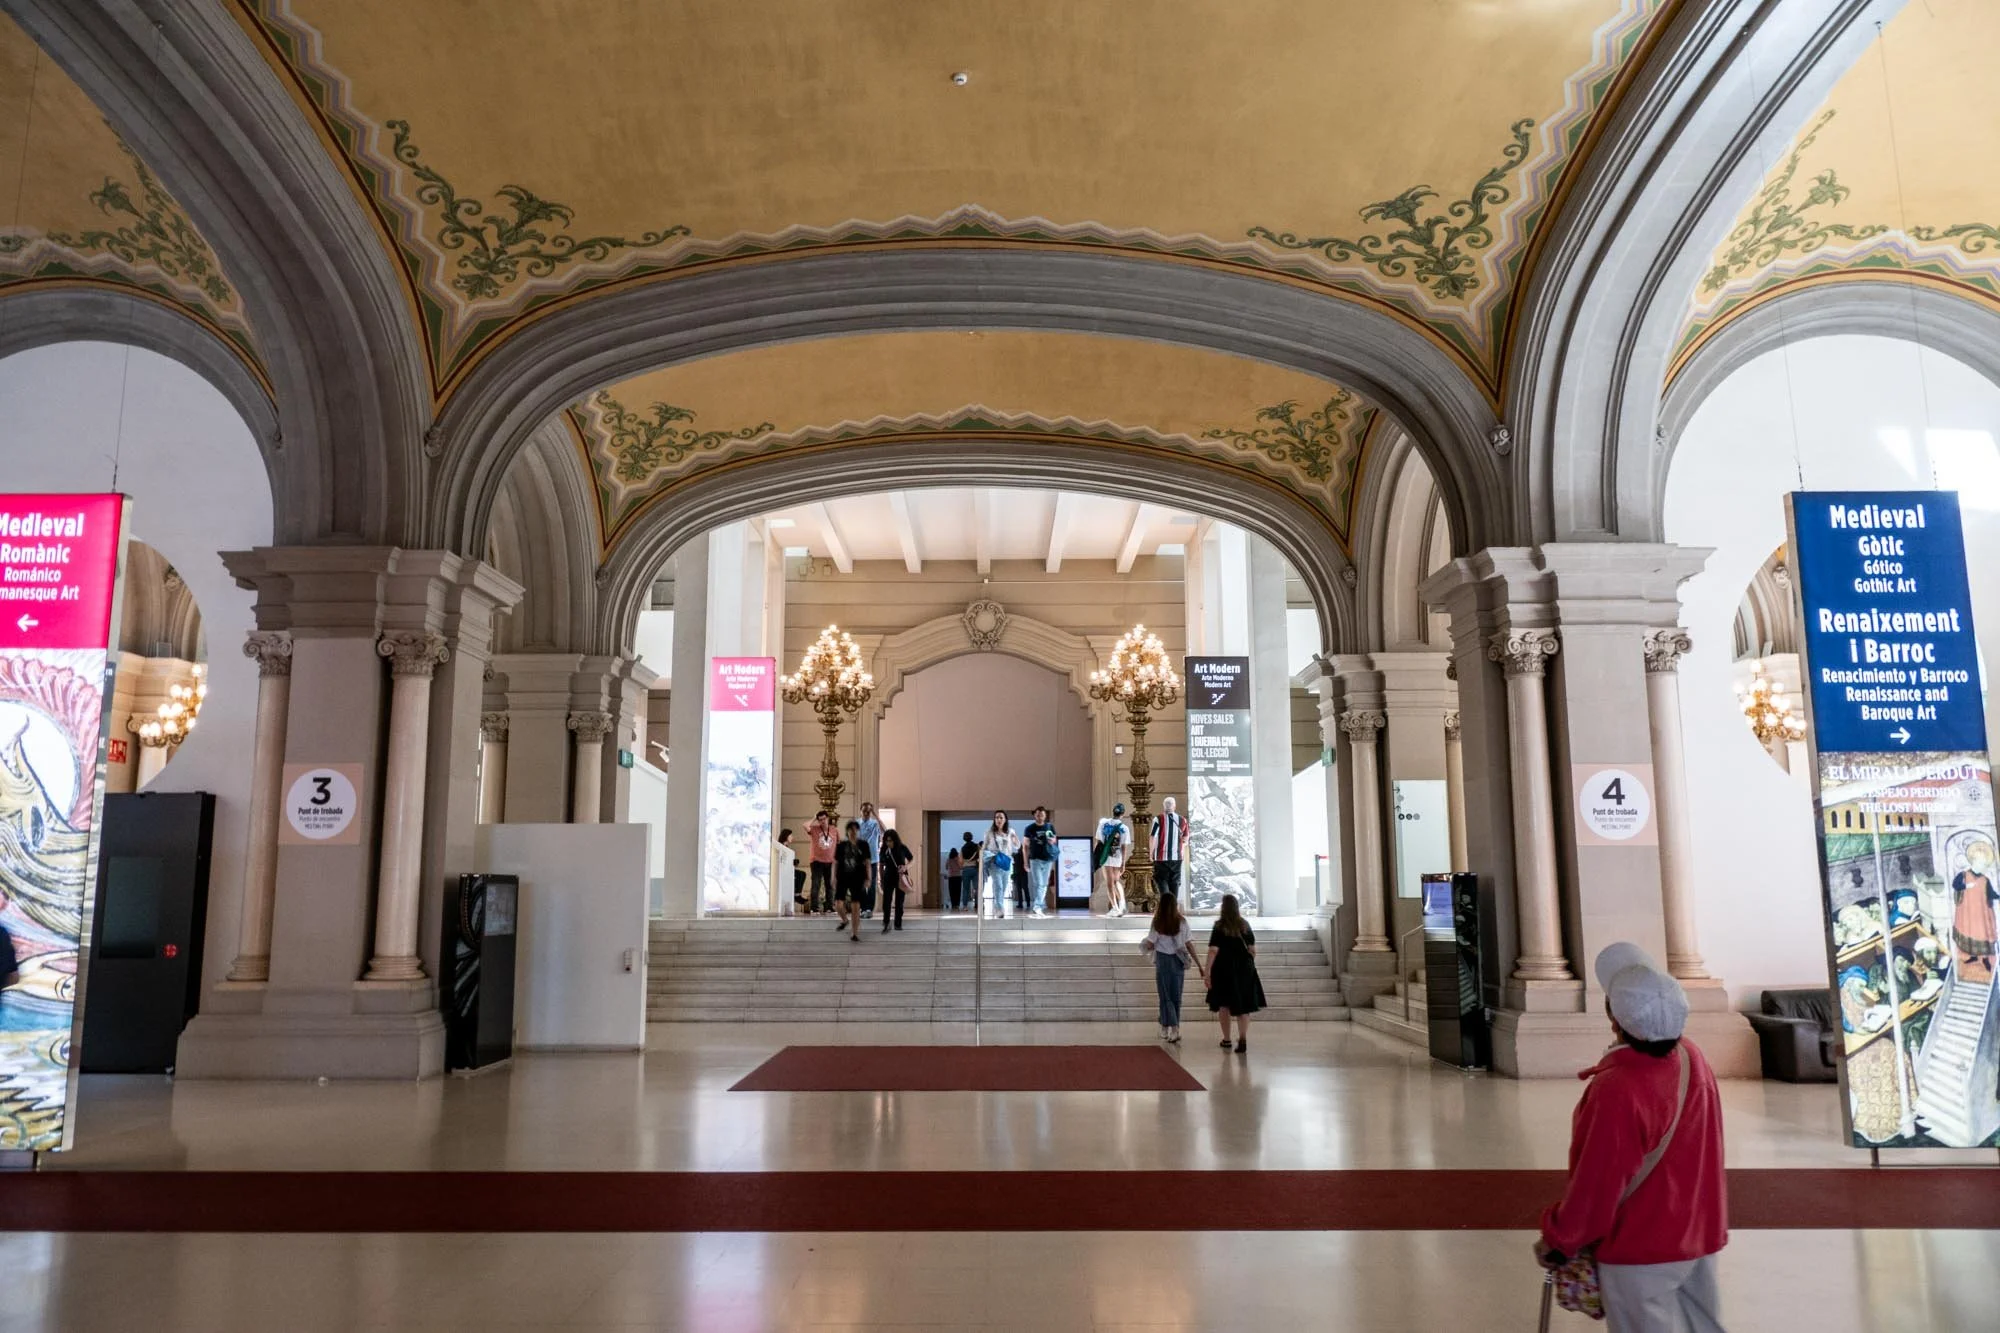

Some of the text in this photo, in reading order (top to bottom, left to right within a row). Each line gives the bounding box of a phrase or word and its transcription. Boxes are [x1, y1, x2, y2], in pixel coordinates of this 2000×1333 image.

[1829, 504, 1926, 529] Medieval
[0, 542, 71, 564] Romànic
[1858, 534, 1905, 556] Gòtic
[4, 567, 62, 582] Románico
[1863, 559, 1903, 575] Gótico
[1854, 577, 1917, 593] Gothic Art
[0, 585, 80, 602] manesque Art
[1818, 608, 1961, 633] Renaixement
[1850, 638, 1936, 663] i Barroc
[719, 664, 766, 675] Art Modern
[1194, 664, 1241, 674] Art Modern
[1822, 667, 1969, 686] Renacimiento y Barroco
[1846, 686, 1949, 702] Renaissance and
[1213, 713, 1234, 724] SALES
[1861, 705, 1937, 722] Baroque Art
[1191, 724, 1205, 735] ART
[1828, 766, 1849, 780] EL
[1916, 765, 1980, 780] PERDUT
[310, 777, 332, 805] 3
[1602, 778, 1625, 805] 4
[298, 807, 312, 815] Punt
[312, 807, 320, 815] de
[1883, 802, 1911, 812] LOST
